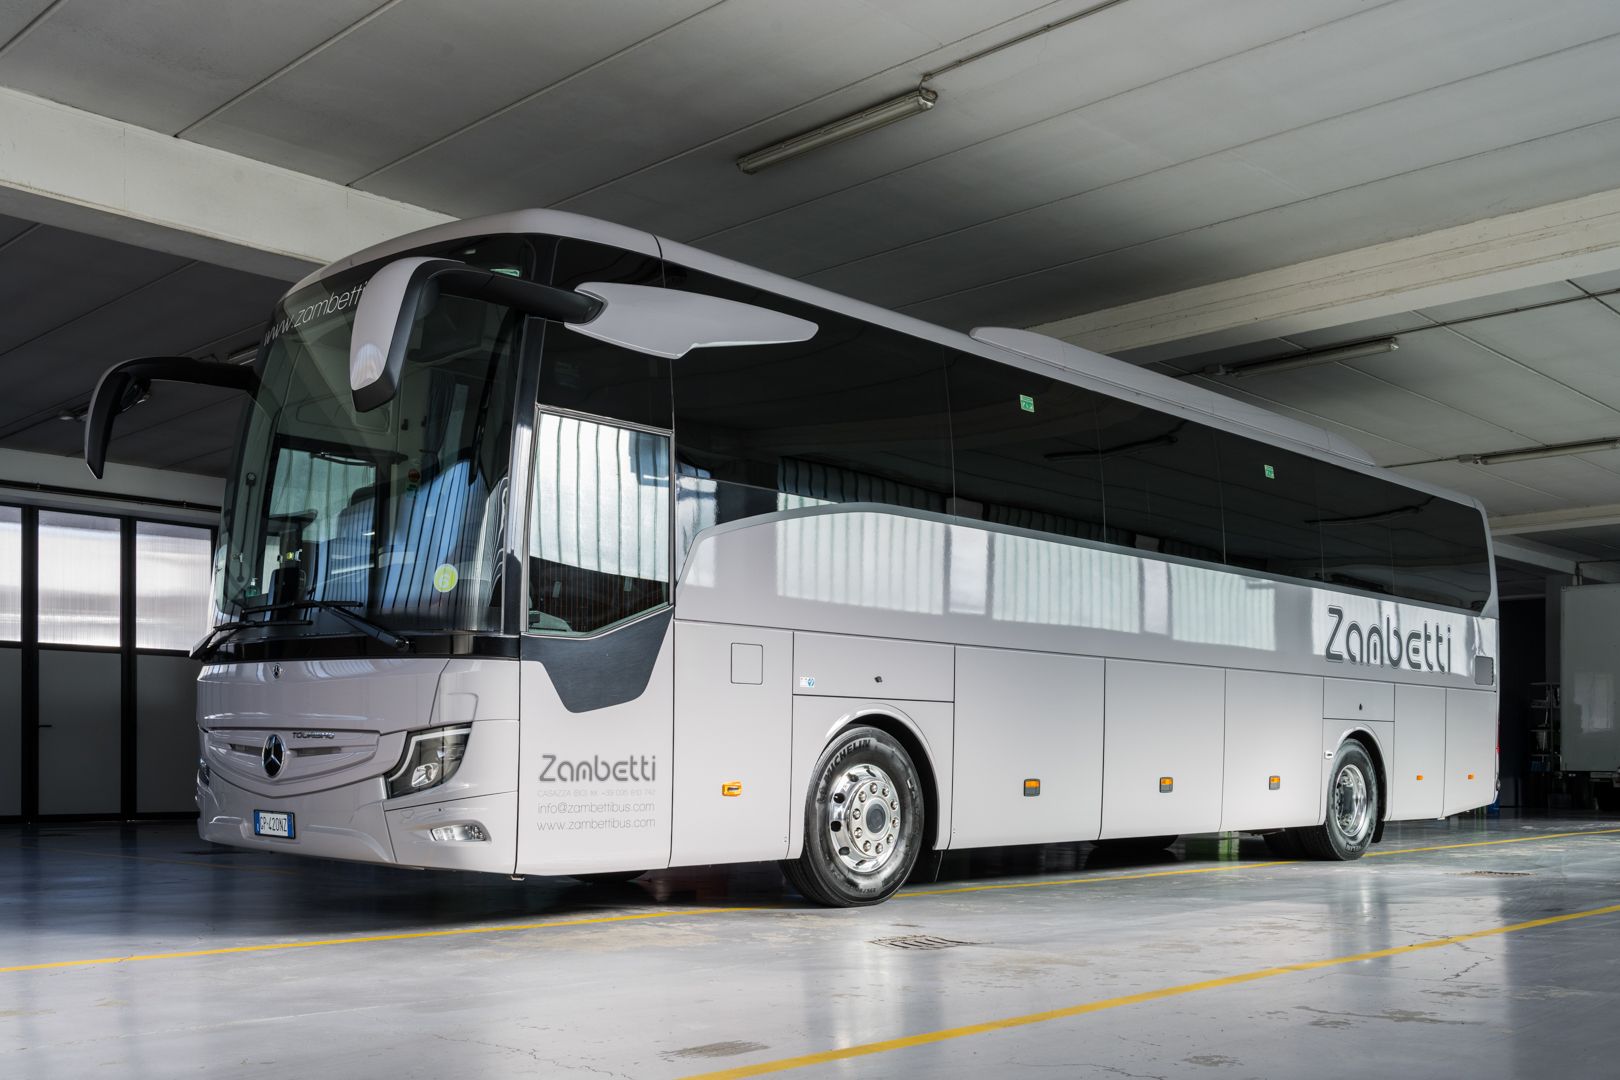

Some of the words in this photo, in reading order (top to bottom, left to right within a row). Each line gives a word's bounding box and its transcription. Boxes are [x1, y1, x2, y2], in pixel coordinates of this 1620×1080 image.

[1325, 604, 1452, 675] Zambetti
[539, 754, 656, 782] Zambetti
[824, 738, 871, 784] MICHELIN
[537, 802, 655, 814] info@zambettibus.com
[536, 818, 656, 831] www.zambettibus.com
